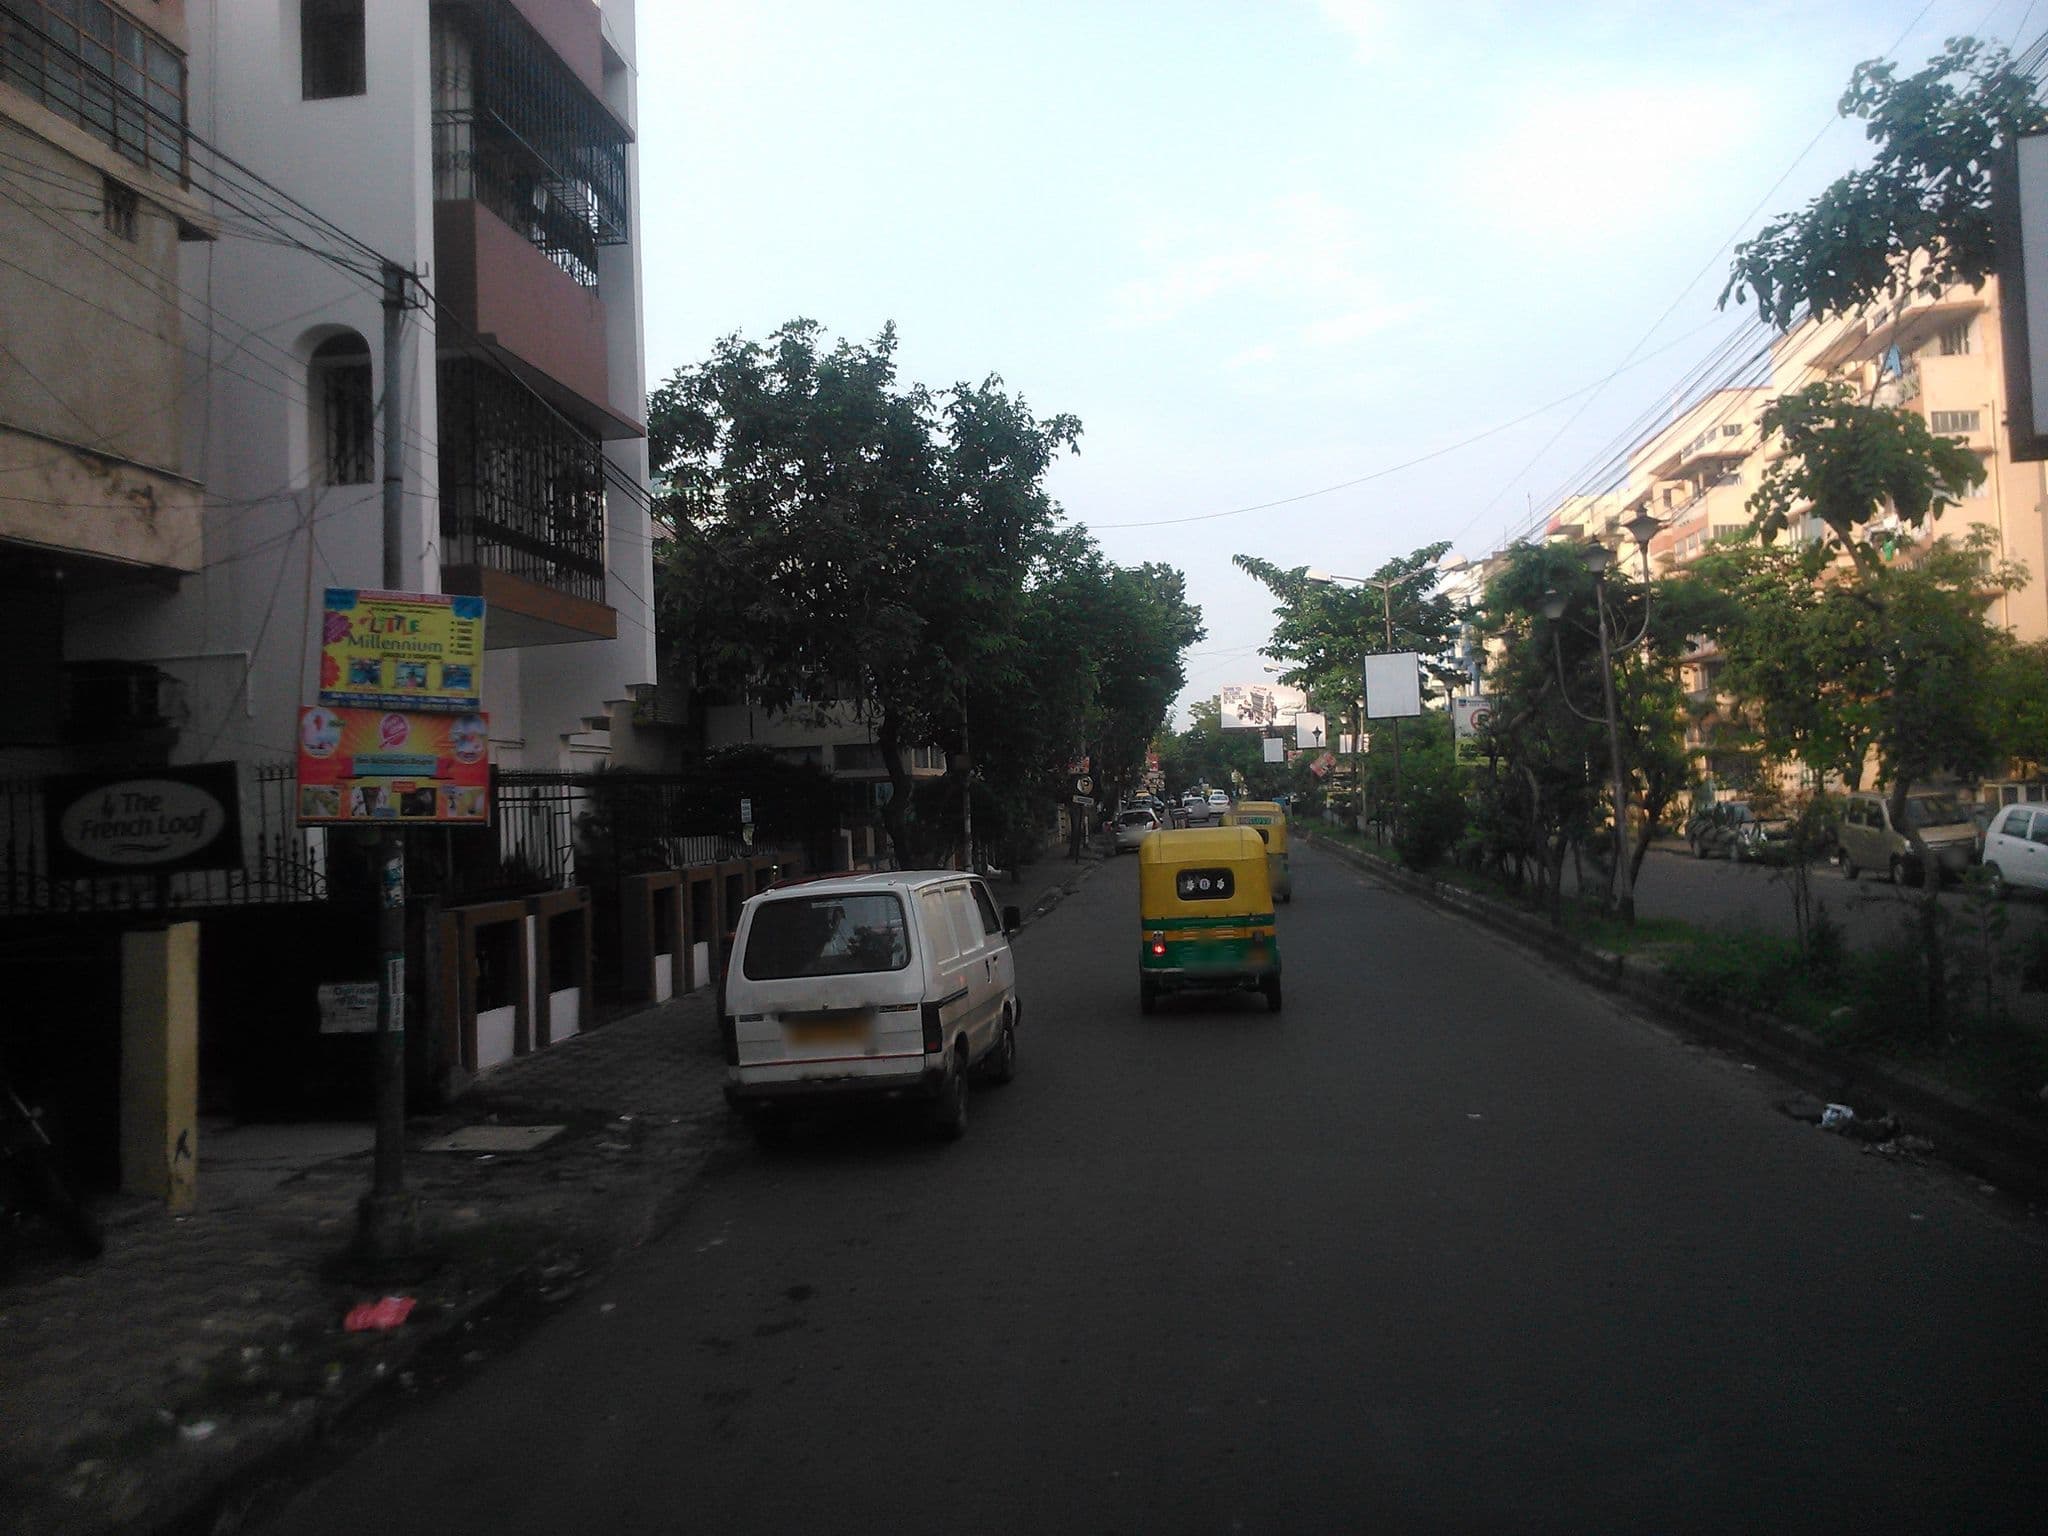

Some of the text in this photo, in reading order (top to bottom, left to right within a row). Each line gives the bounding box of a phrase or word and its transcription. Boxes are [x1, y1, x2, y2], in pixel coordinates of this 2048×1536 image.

[347, 633, 444, 653] Millennium
[119, 792, 162, 814] The
[79, 808, 208, 840] French Loaf
